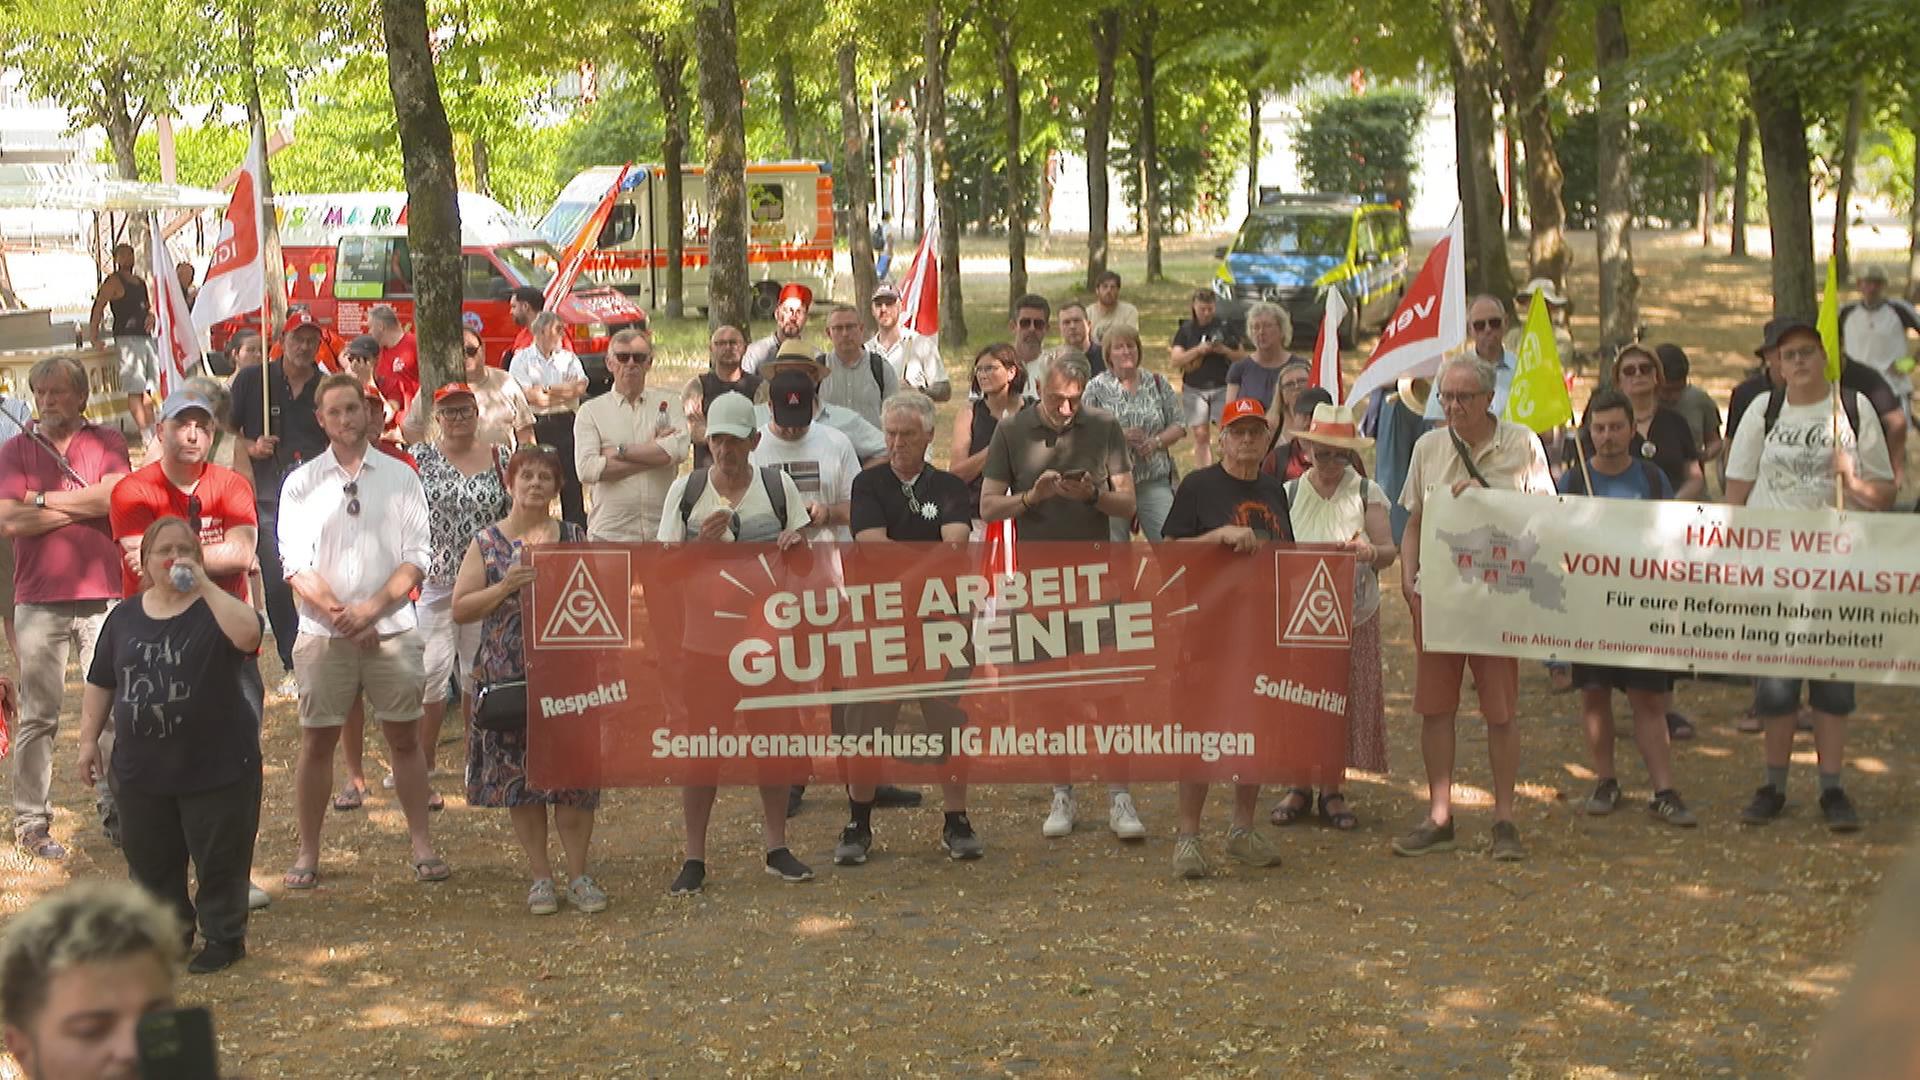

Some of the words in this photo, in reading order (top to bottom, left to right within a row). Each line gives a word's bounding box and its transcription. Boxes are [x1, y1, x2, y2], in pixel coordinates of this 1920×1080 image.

[1686, 520, 1782, 551] HÄNDE
[1790, 529, 1852, 555] WEG
[1563, 552, 1621, 577] VON
[1629, 558, 1764, 587] UNSEREM
[763, 581, 904, 630] GUTE
[916, 562, 1110, 618] ARBEIT
[1606, 591, 1634, 609] Für
[1640, 596, 1679, 611] eure
[1684, 597, 1771, 618] Reformen
[1776, 602, 1832, 621] haben
[1838, 605, 1874, 624] WIR
[728, 625, 909, 687] GUTE
[921, 601, 1155, 671] RENTE
[1502, 631, 1528, 645] Eine
[1531, 633, 1571, 650] Aktion
[1574, 637, 1595, 651] der
[1598, 638, 1729, 662] Seniorenausschüsse
[1731, 648, 1752, 663] der
[1755, 652, 1856, 669] saarländischen
[1649, 620, 1676, 636] ein
[1680, 621, 1736, 641] Leben
[1741, 624, 1780, 647] lang
[1784, 630, 1884, 649] gearbeitet!
[539, 679, 629, 719] Respekt!
[1253, 673, 1348, 716] Solidarität!
[651, 726, 944, 759] Seniorenausschuss
[951, 726, 983, 756] IG
[989, 724, 1088, 756] Metall
[1093, 722, 1256, 762] Völklingen
